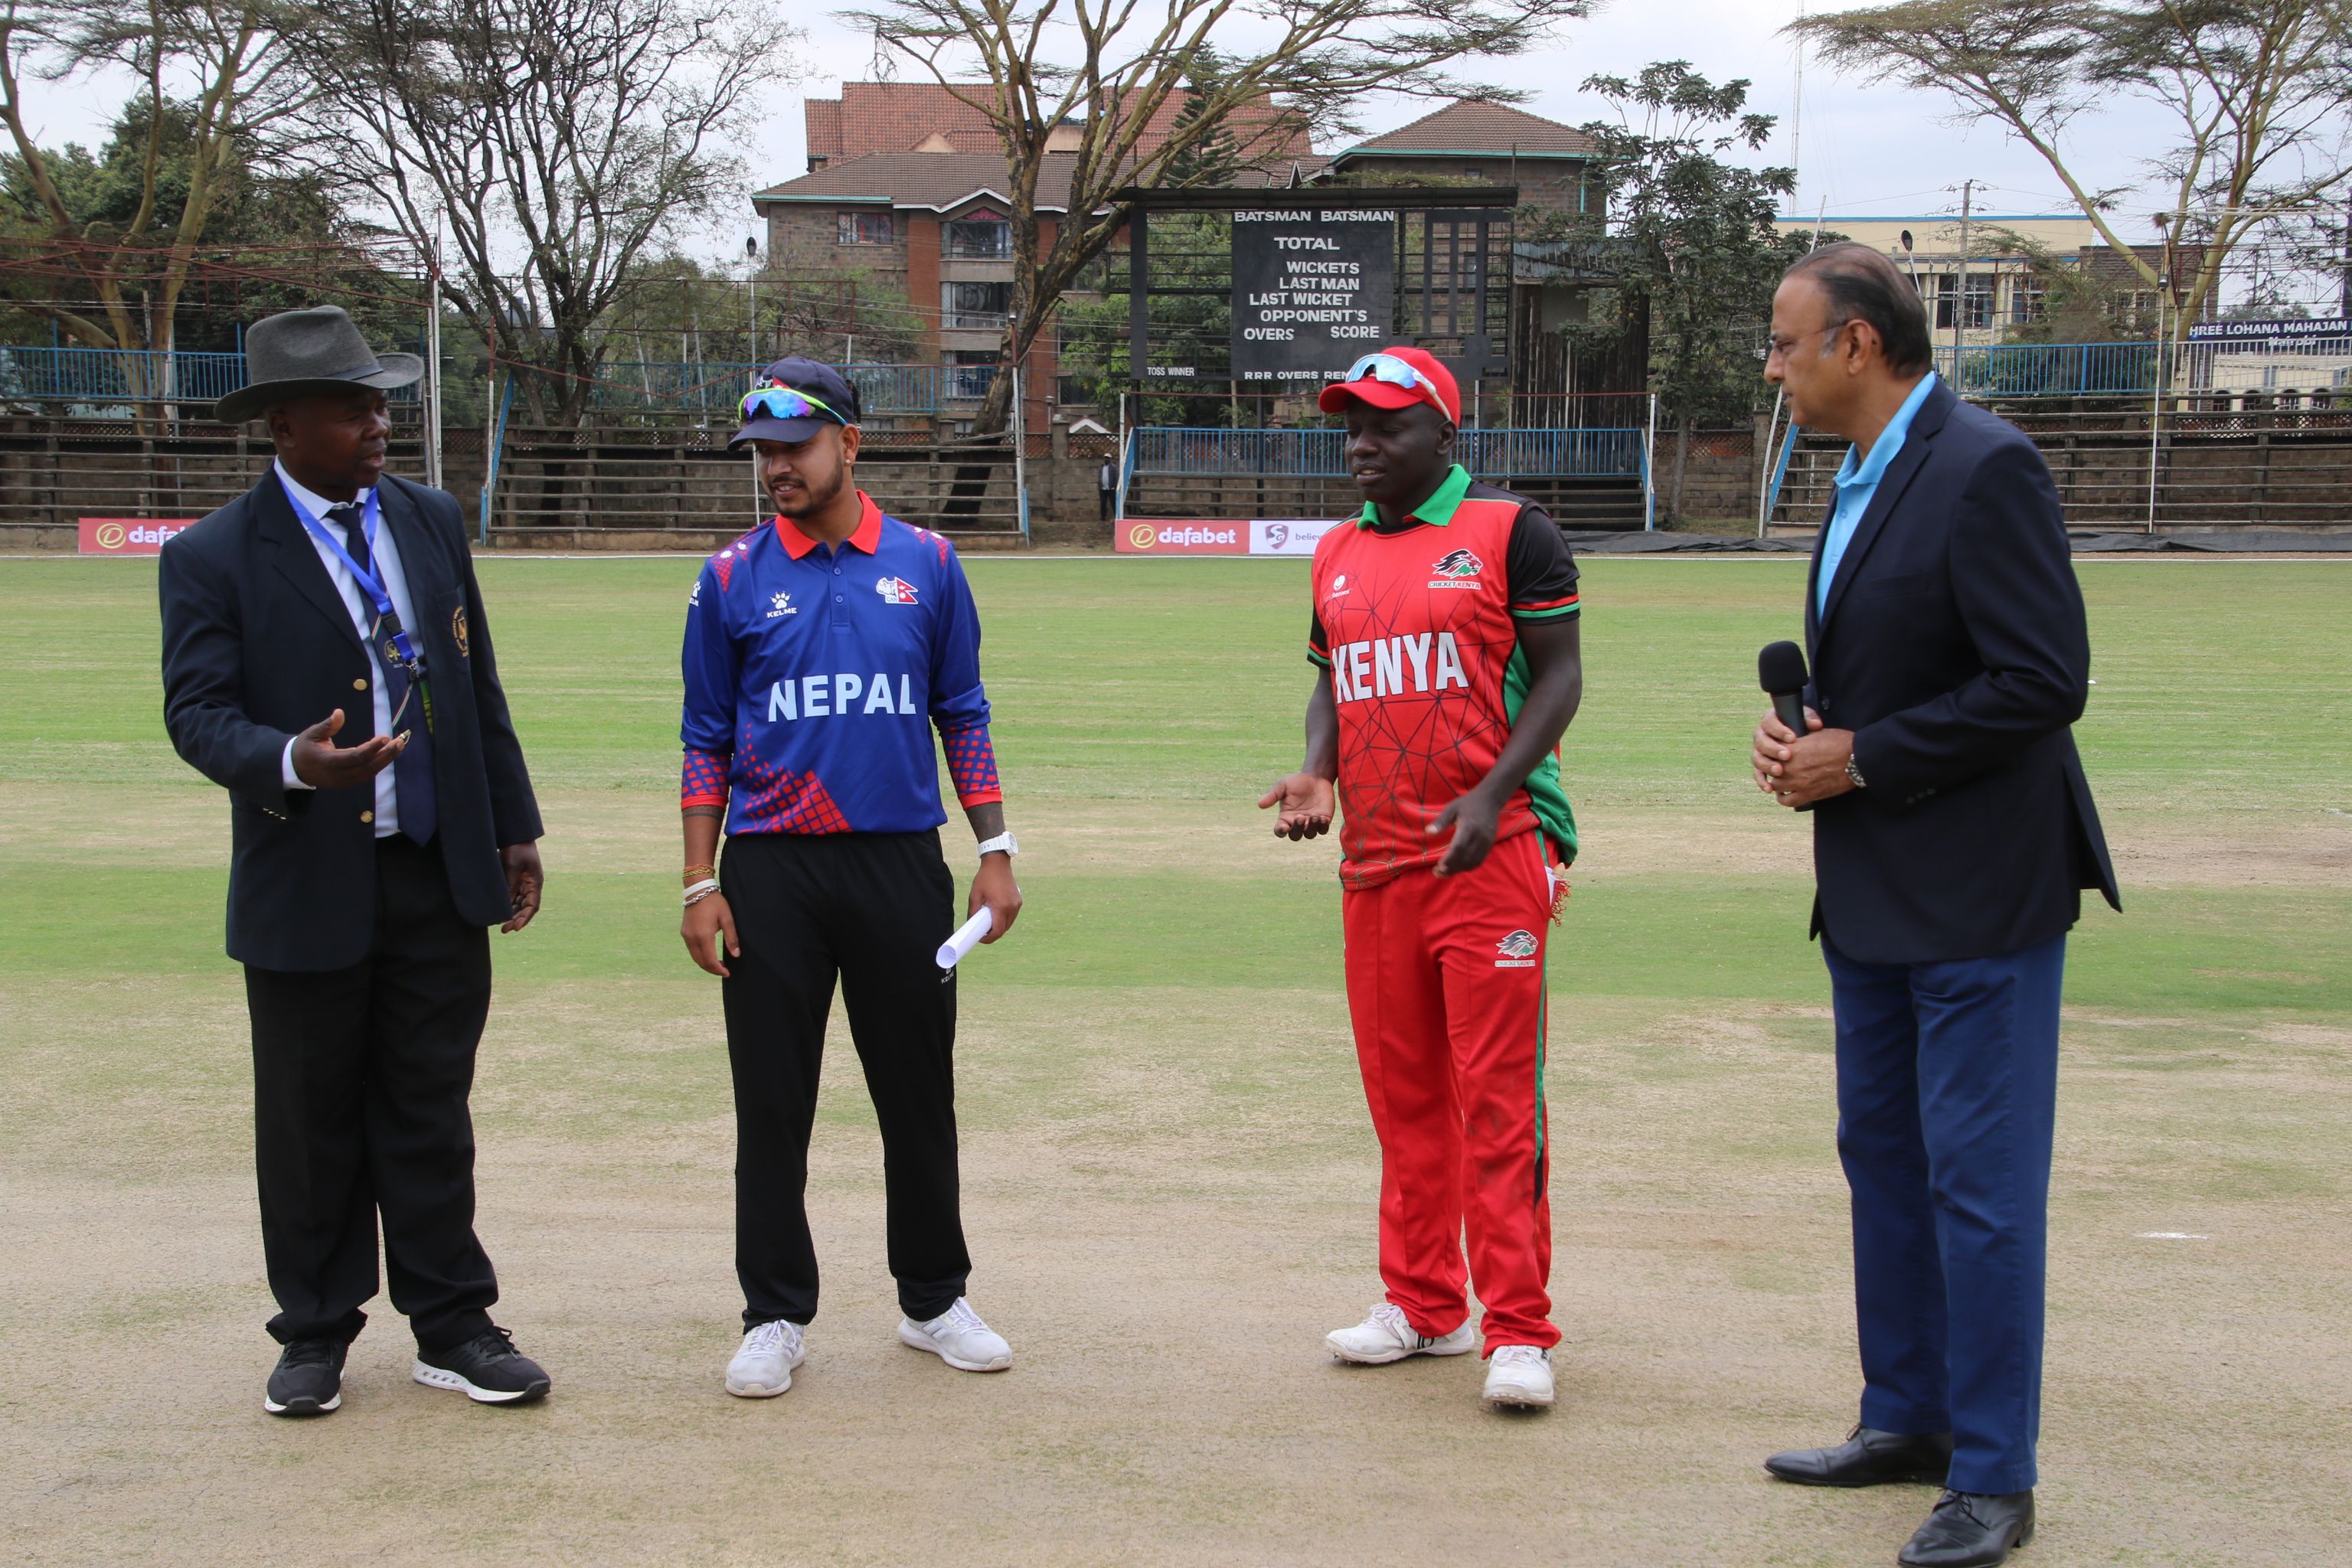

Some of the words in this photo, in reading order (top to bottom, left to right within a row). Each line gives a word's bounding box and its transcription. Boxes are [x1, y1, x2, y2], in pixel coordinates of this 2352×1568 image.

[1234, 211, 1312, 222] BATSMAN
[1321, 211, 1394, 222] BATSMAN
[1274, 237, 1340, 250] TOTAL
[1286, 261, 1360, 274] WICKETS
[1279, 277, 1318, 289] LAST
[1321, 278, 1360, 290] MAN
[1250, 292, 1289, 305] LAST
[1292, 293, 1353, 306] WICKET
[1260, 309, 1367, 322] OPPONENT'S
[1331, 325, 1380, 338] SCORE
[2226, 323, 2280, 335] LOHANA
[2283, 320, 2348, 333] MAHAJAN
[1244, 328, 1295, 341] OVERS
[1147, 367, 1165, 376] TOSS
[1168, 367, 1194, 377] WINNER
[1244, 371, 1272, 380] RRR
[1277, 371, 1318, 380] OVERS
[1158, 527, 1236, 547] dafabet
[766, 607, 798, 619] KELME
[1331, 632, 1469, 704] KENYA
[768, 674, 916, 723] NEPAL
